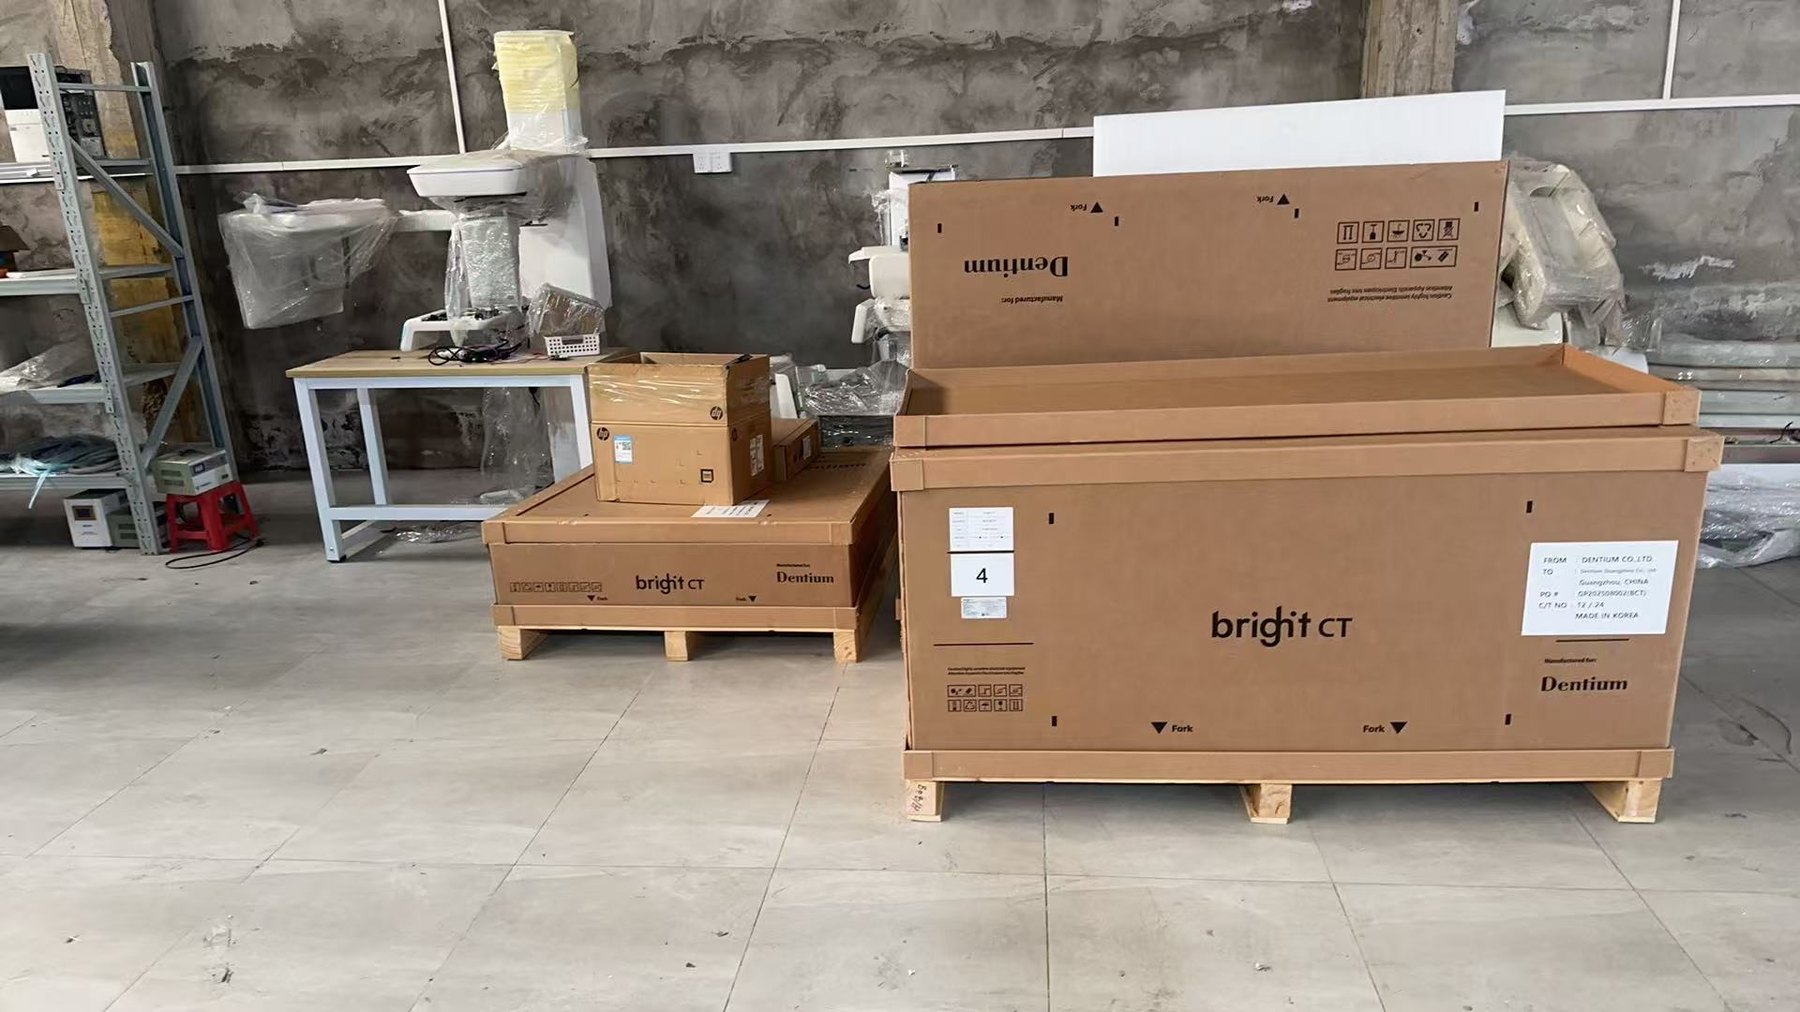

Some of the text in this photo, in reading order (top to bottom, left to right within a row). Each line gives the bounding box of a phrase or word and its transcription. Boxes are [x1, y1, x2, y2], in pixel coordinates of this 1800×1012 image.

[1256, 195, 1274, 204] Fork
[1070, 203, 1087, 212] Fork
[964, 256, 1068, 278] Dentium
[1015, 295, 1063, 304] Manufactured
[777, 571, 834, 584] Dentium
[976, 567, 988, 583] 4
[688, 579, 704, 590] CT
[1318, 617, 1353, 638] CT
[1541, 676, 1628, 692] Dentium
[1171, 724, 1194, 733] Fork
[1362, 724, 1385, 733] Fork
